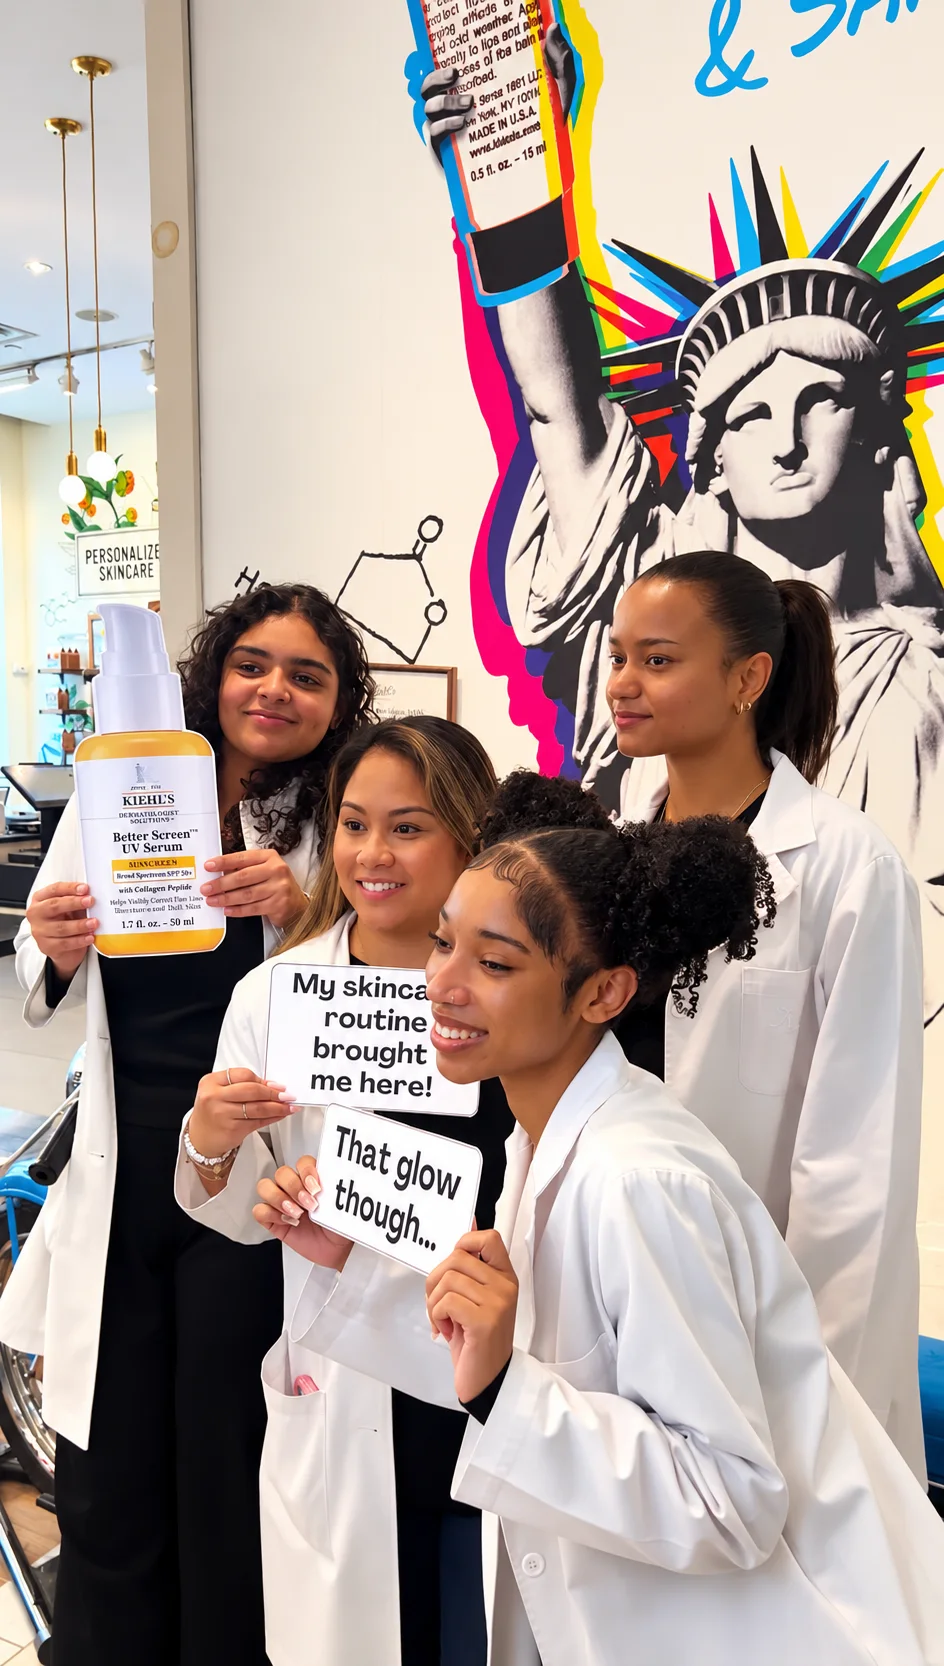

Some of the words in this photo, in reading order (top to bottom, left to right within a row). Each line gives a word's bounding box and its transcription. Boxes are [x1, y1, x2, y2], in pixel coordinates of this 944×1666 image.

[695, 0, 769, 97] &
[468, 122, 496, 144] MADE
[497, 117, 508, 132] IN
[510, 106, 537, 125] U.S.A.
[470, 170, 484, 182] 0.5
[487, 163, 496, 176] fl.
[498, 158, 513, 172] oz.
[522, 147, 534, 160] 15
[536, 141, 547, 156] ml
[99, 562, 154, 582] SKINCARE
[122, 794, 176, 806] KIEHL'S
[113, 832, 149, 842] Better
[122, 844, 140, 854] UV
[143, 843, 183, 853] Serum
[134, 885, 166, 894] Collagen
[122, 920, 134, 929] 1.7
[136, 920, 146, 928] fl.
[170, 918, 181, 926] 50
[183, 917, 194, 926] ml
[292, 972, 336, 1001] My
[324, 1008, 428, 1033] routine
[313, 1036, 428, 1069] brought
[310, 1073, 352, 1092] me
[360, 1071, 432, 1098] here!
[336, 1125, 392, 1176] That
[394, 1150, 462, 1201] glow
[335, 1179, 437, 1252] though...
